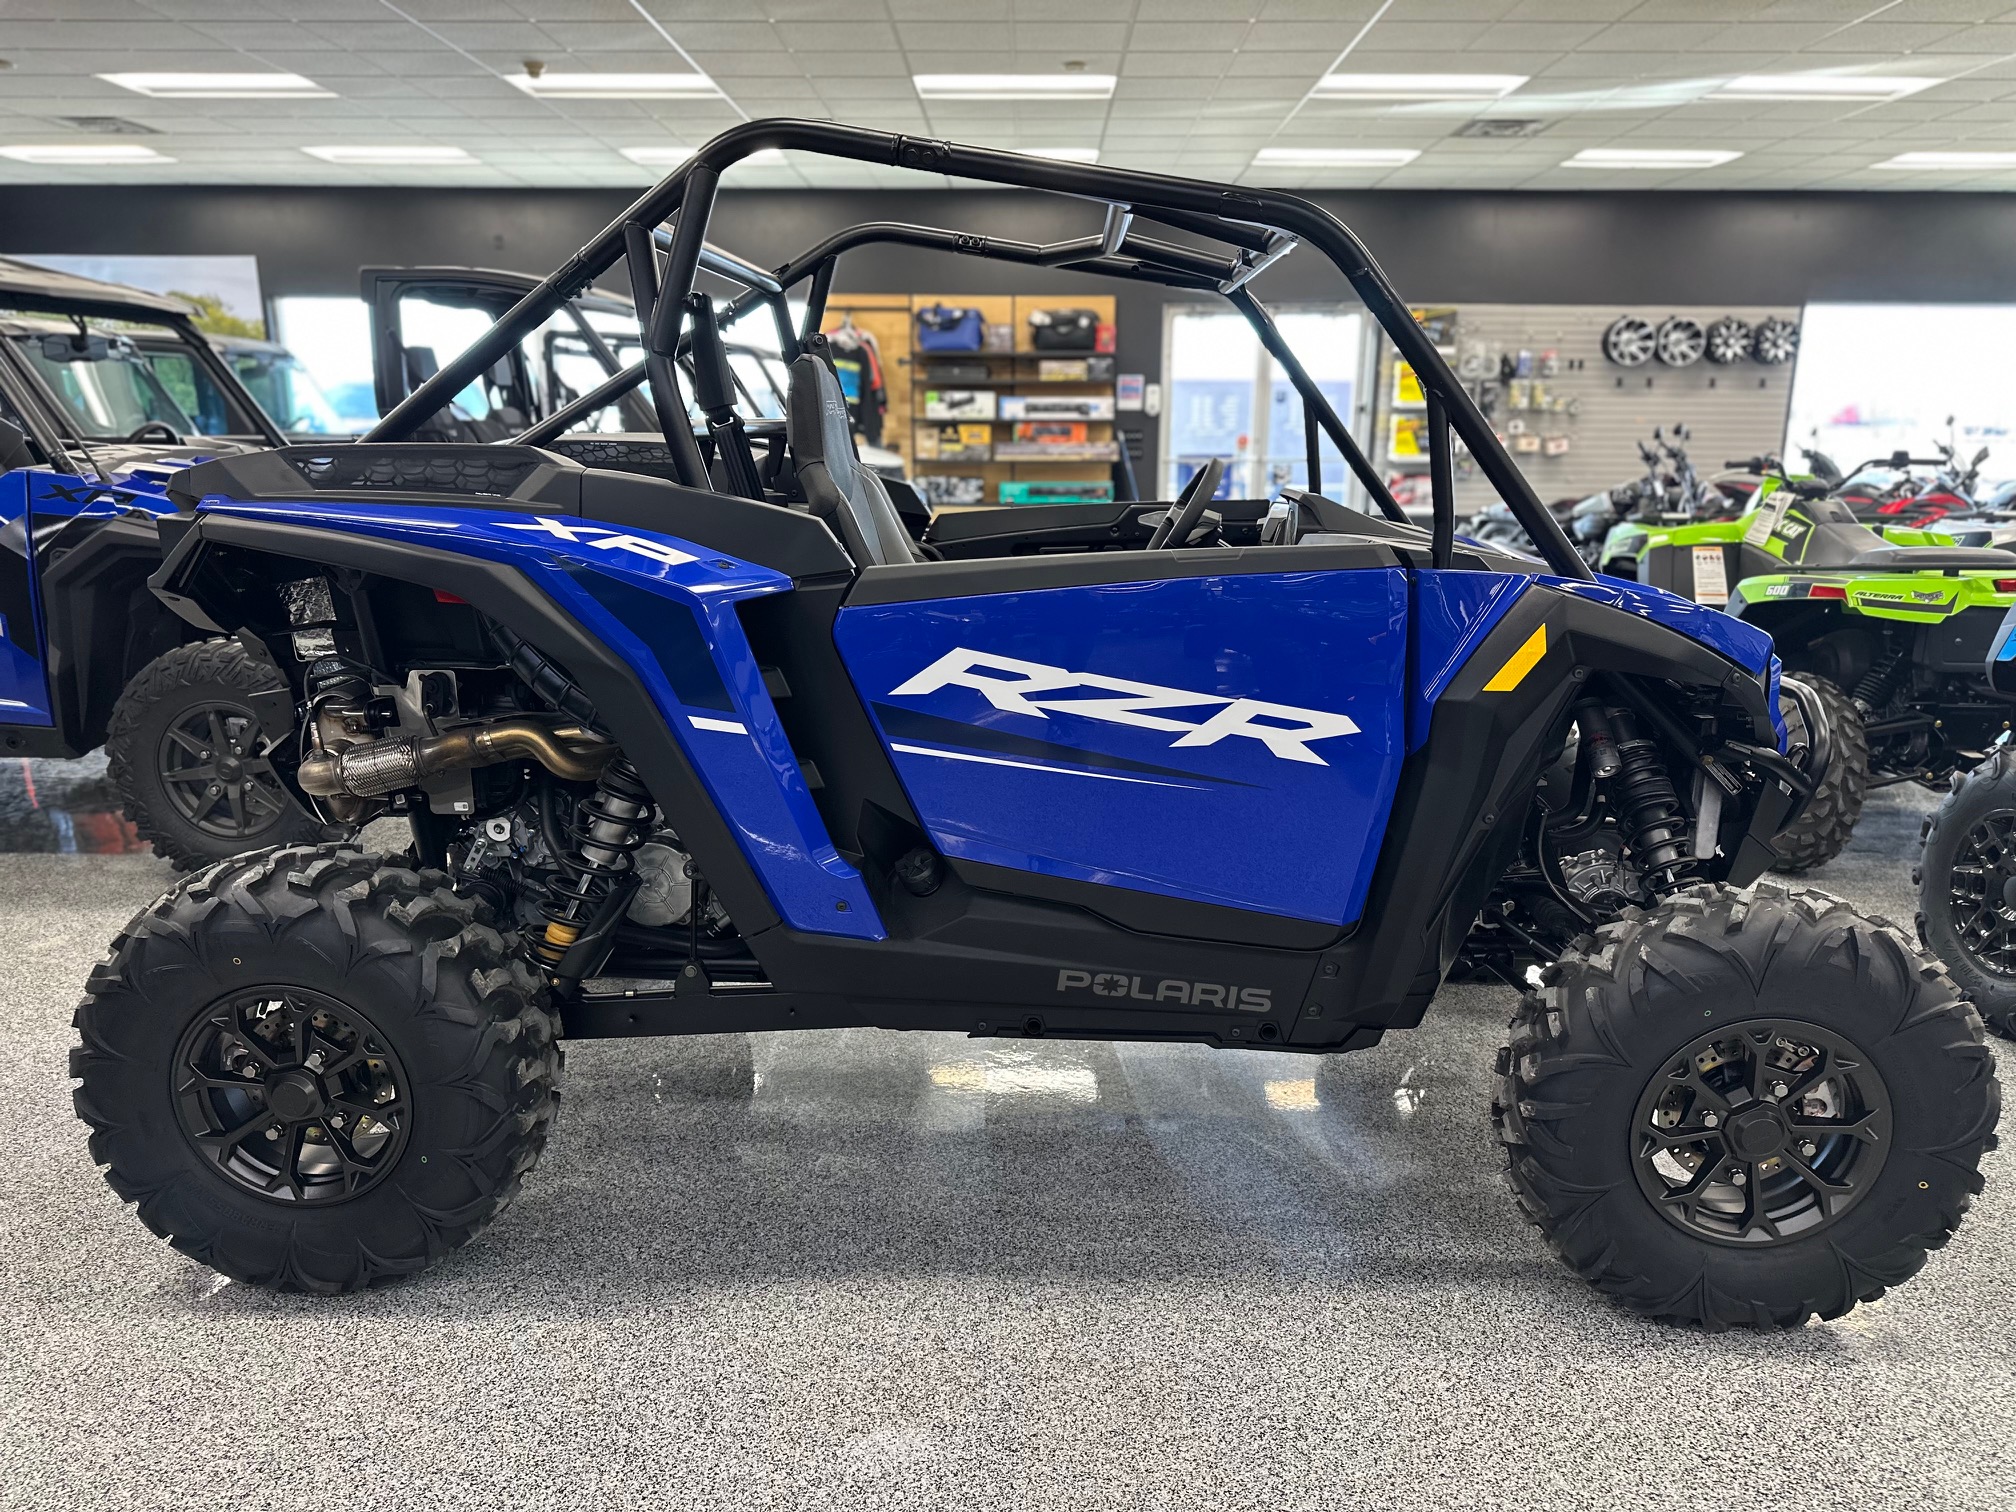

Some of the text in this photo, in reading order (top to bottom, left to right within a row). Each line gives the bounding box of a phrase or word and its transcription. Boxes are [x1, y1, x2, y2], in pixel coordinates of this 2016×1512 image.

[489, 516, 701, 566] XP
[1765, 585, 1791, 596] 600
[1854, 590, 1904, 600] ALTERRA
[888, 646, 1362, 767] RZR
[1056, 969, 1273, 1013] POLARIS
